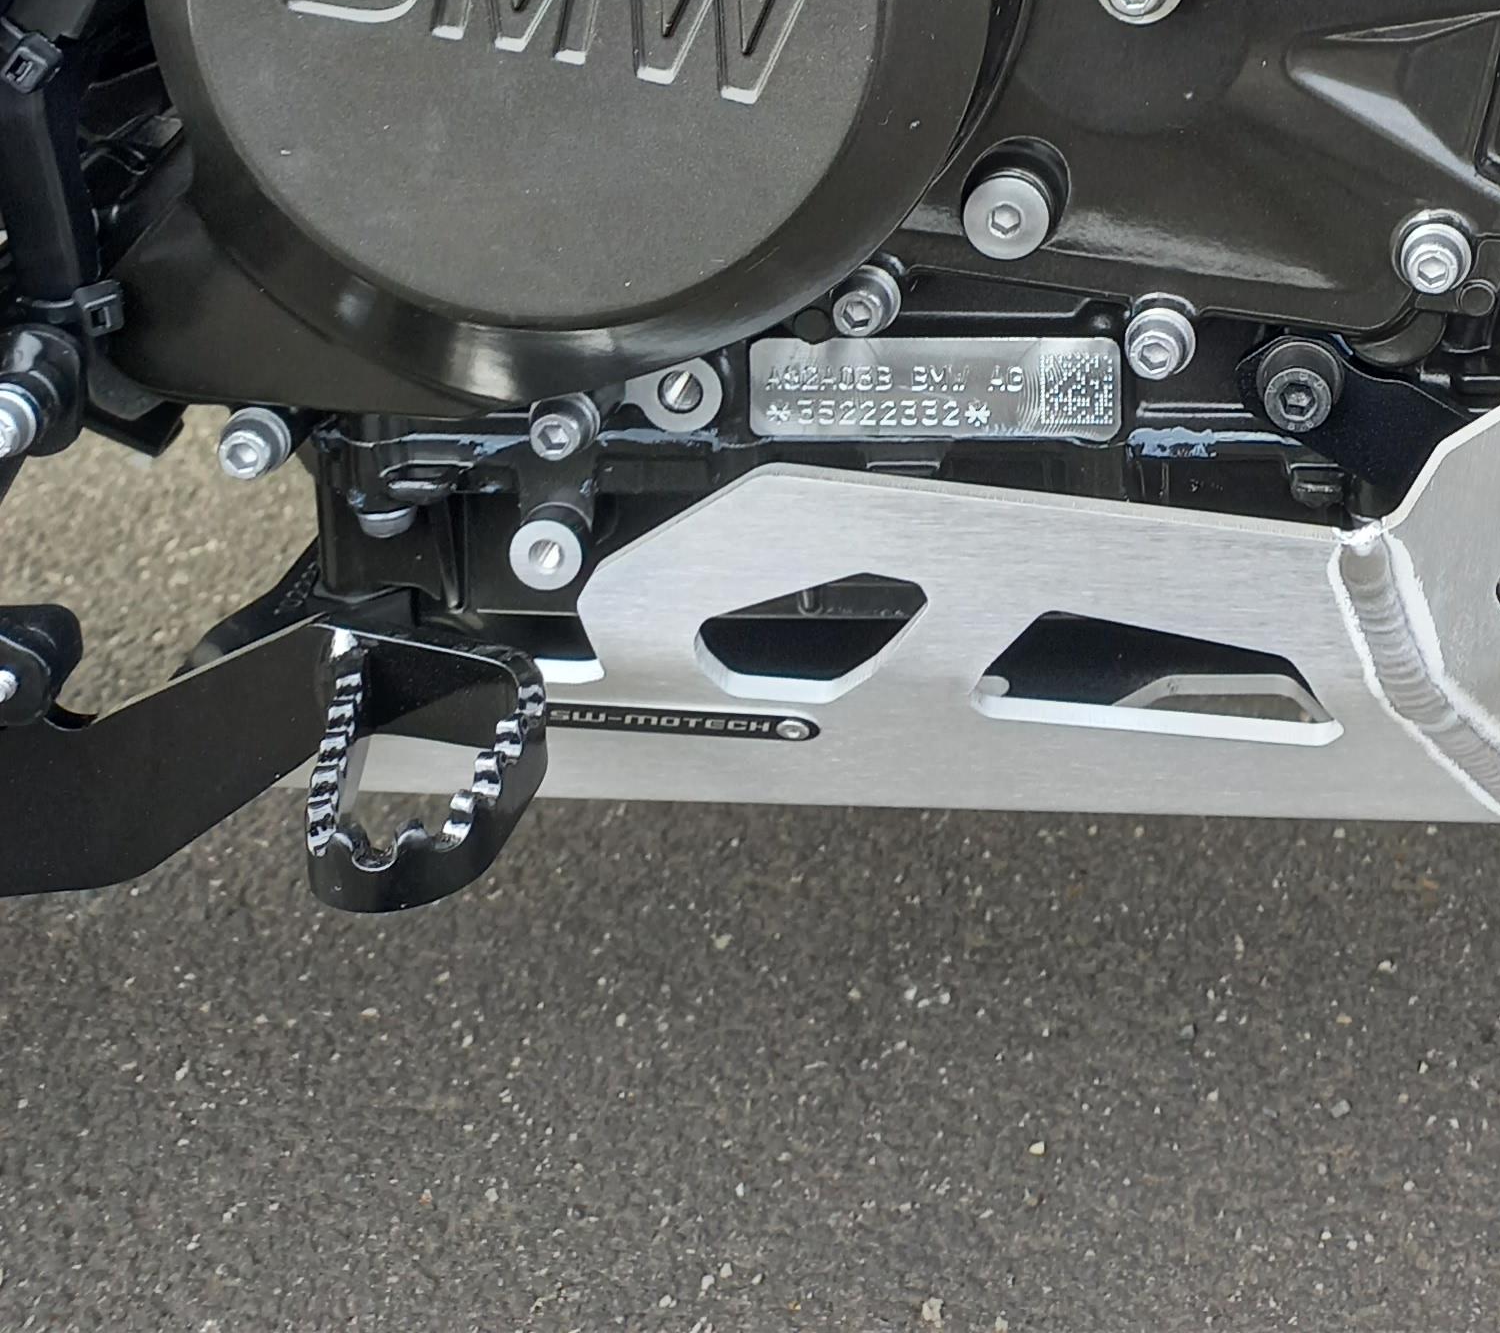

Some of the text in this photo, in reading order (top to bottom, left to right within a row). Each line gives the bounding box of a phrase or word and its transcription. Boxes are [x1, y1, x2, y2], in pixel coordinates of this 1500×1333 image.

[911, 364, 970, 392] BMW
[988, 364, 1024, 393] AG
[549, 708, 771, 733] SW-MOTECH
